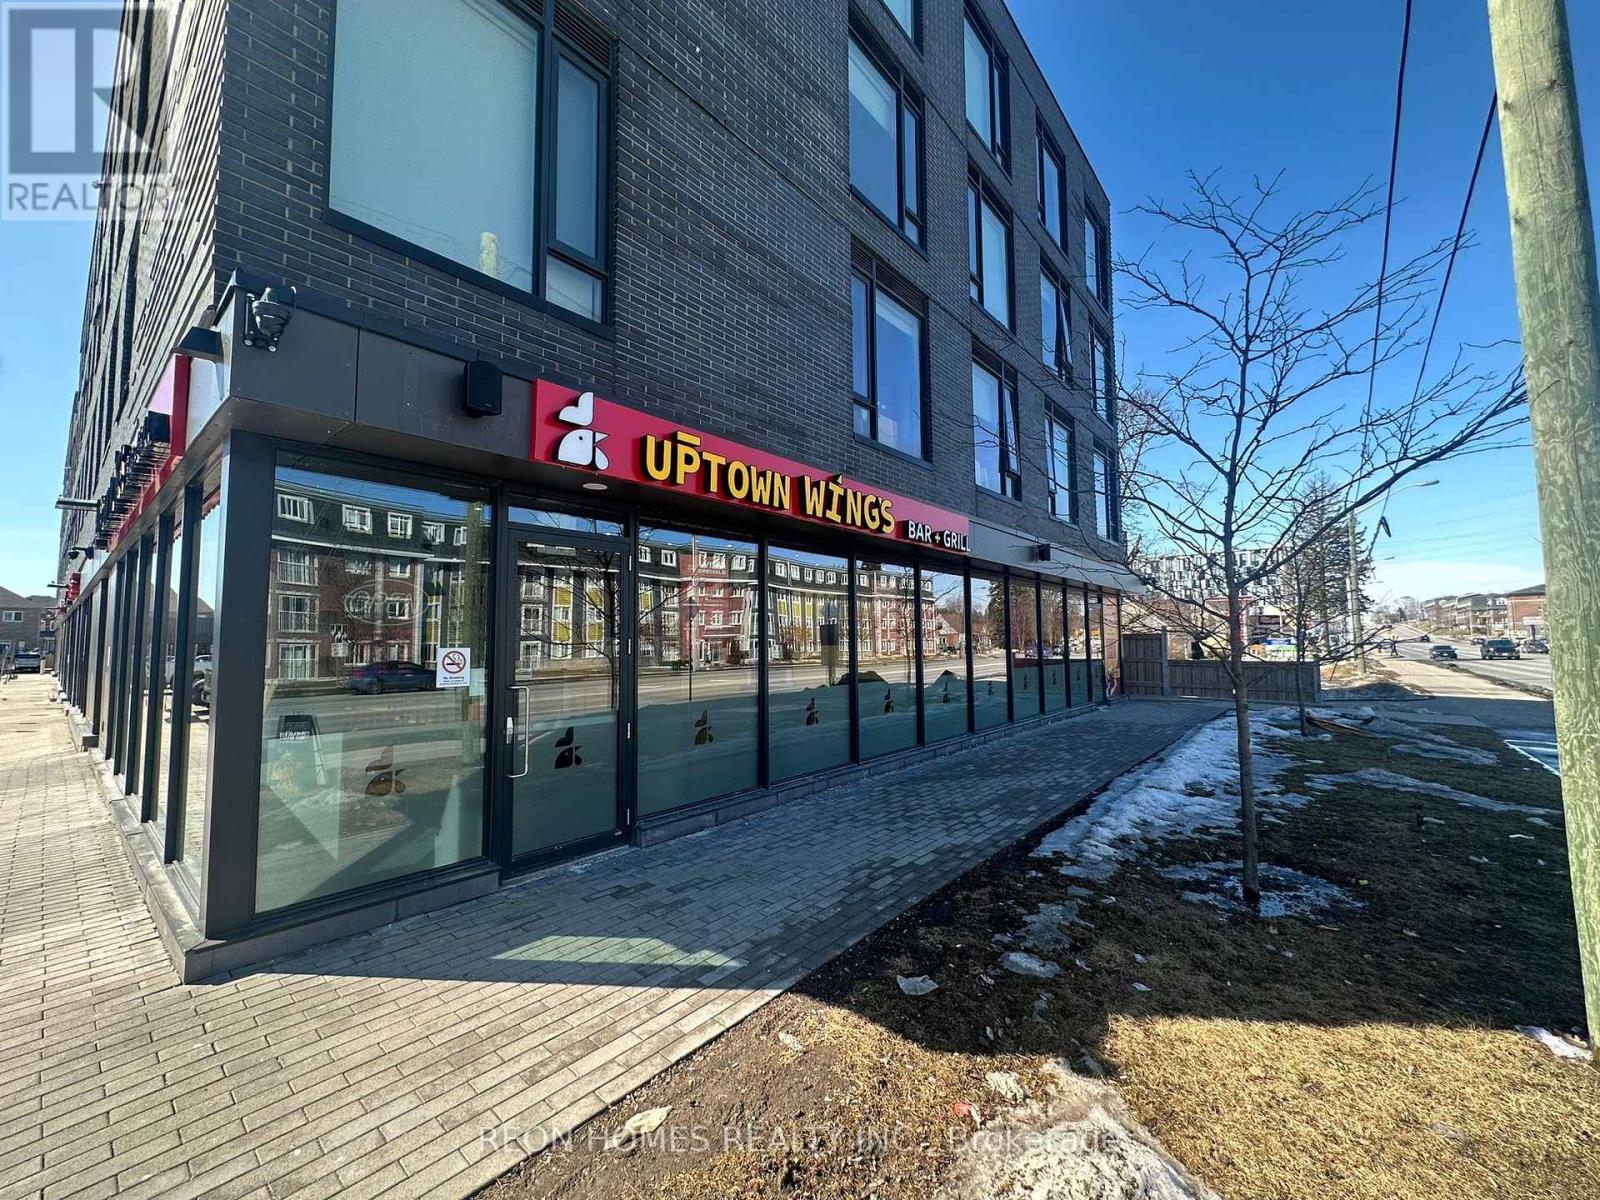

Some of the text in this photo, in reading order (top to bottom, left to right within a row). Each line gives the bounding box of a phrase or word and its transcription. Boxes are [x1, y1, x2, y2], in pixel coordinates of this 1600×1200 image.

[645, 431, 791, 510] UPTOWN
[908, 520, 932, 543] BAR
[942, 530, 972, 552] GRILL
